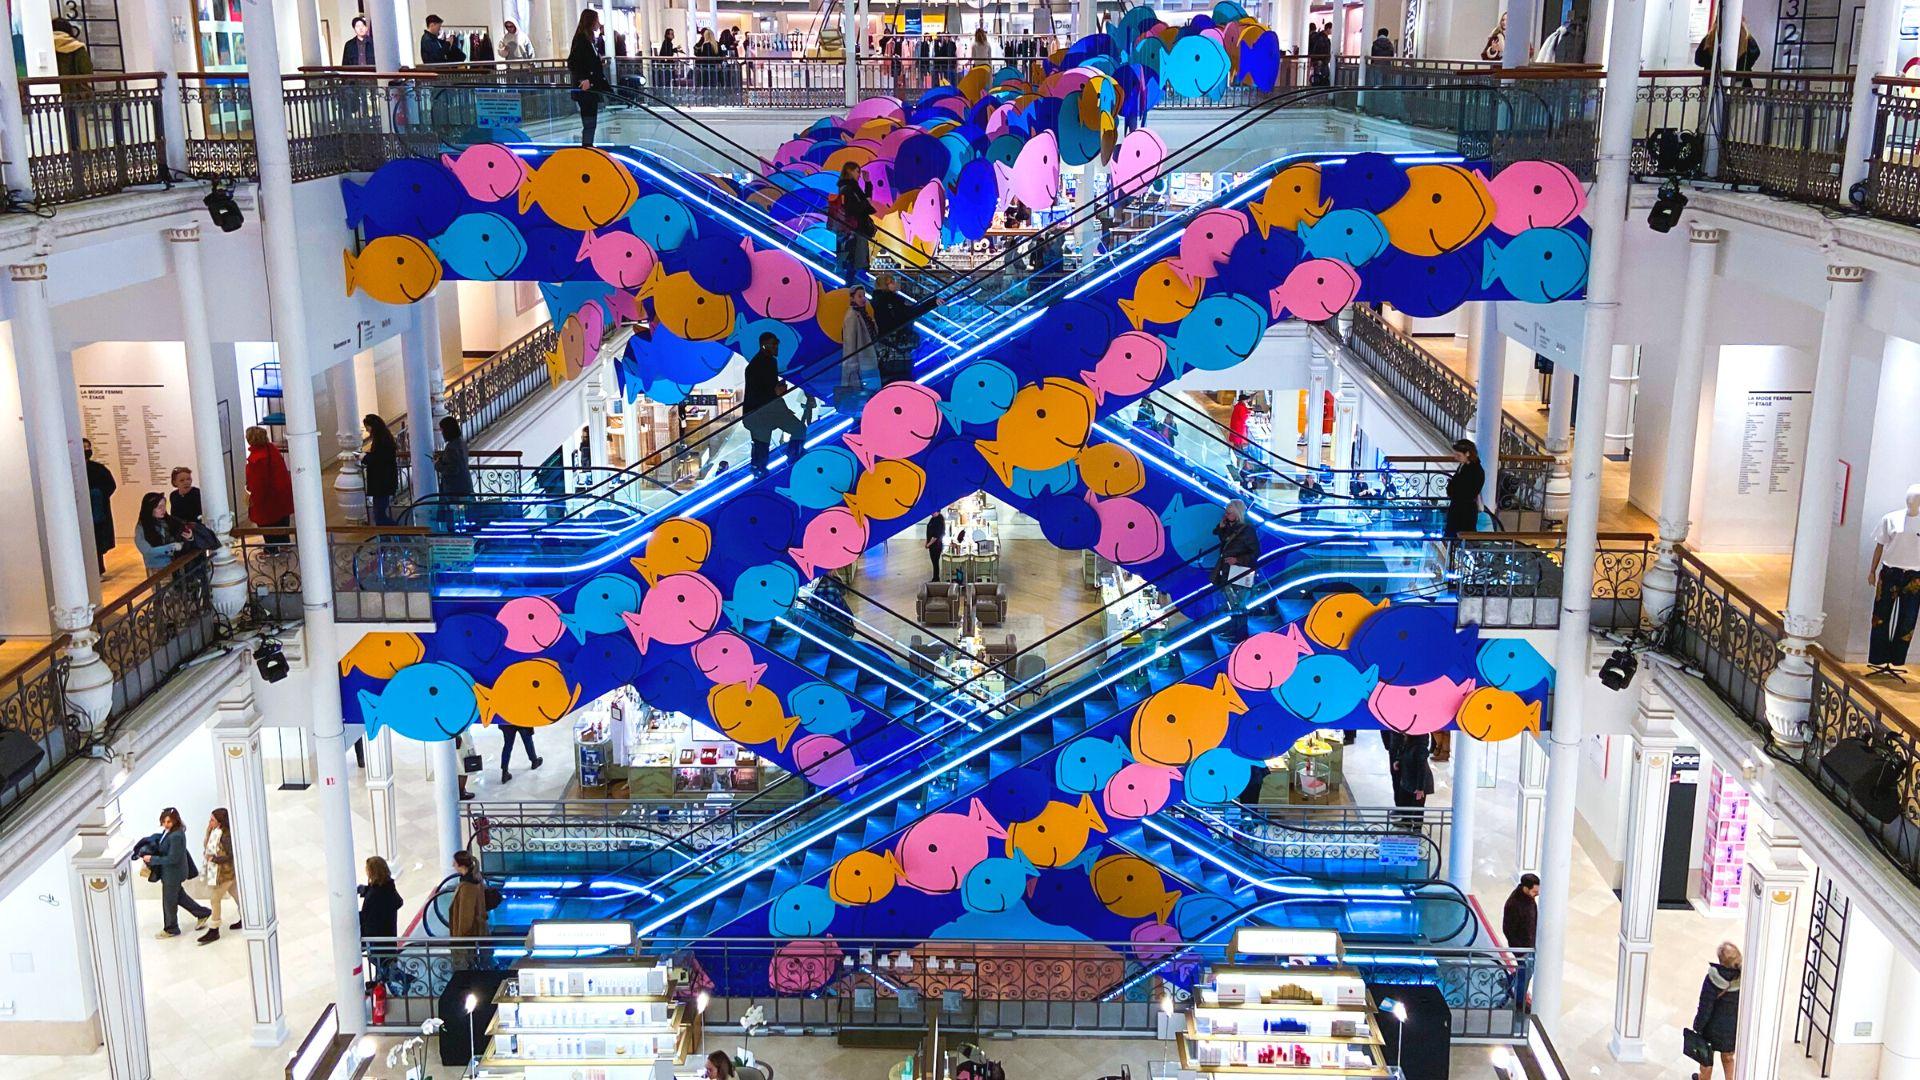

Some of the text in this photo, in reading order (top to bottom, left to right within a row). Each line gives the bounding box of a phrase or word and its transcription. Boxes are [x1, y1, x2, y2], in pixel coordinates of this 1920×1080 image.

[66, 0, 78, 20] 3
[1786, 0, 1799, 16] 3
[1783, 24, 1796, 43] 2
[1783, 49, 1791, 69] 1
[1816, 900, 1824, 920] 3
[1812, 949, 1818, 969] 1
[1807, 971, 1815, 990] 0
